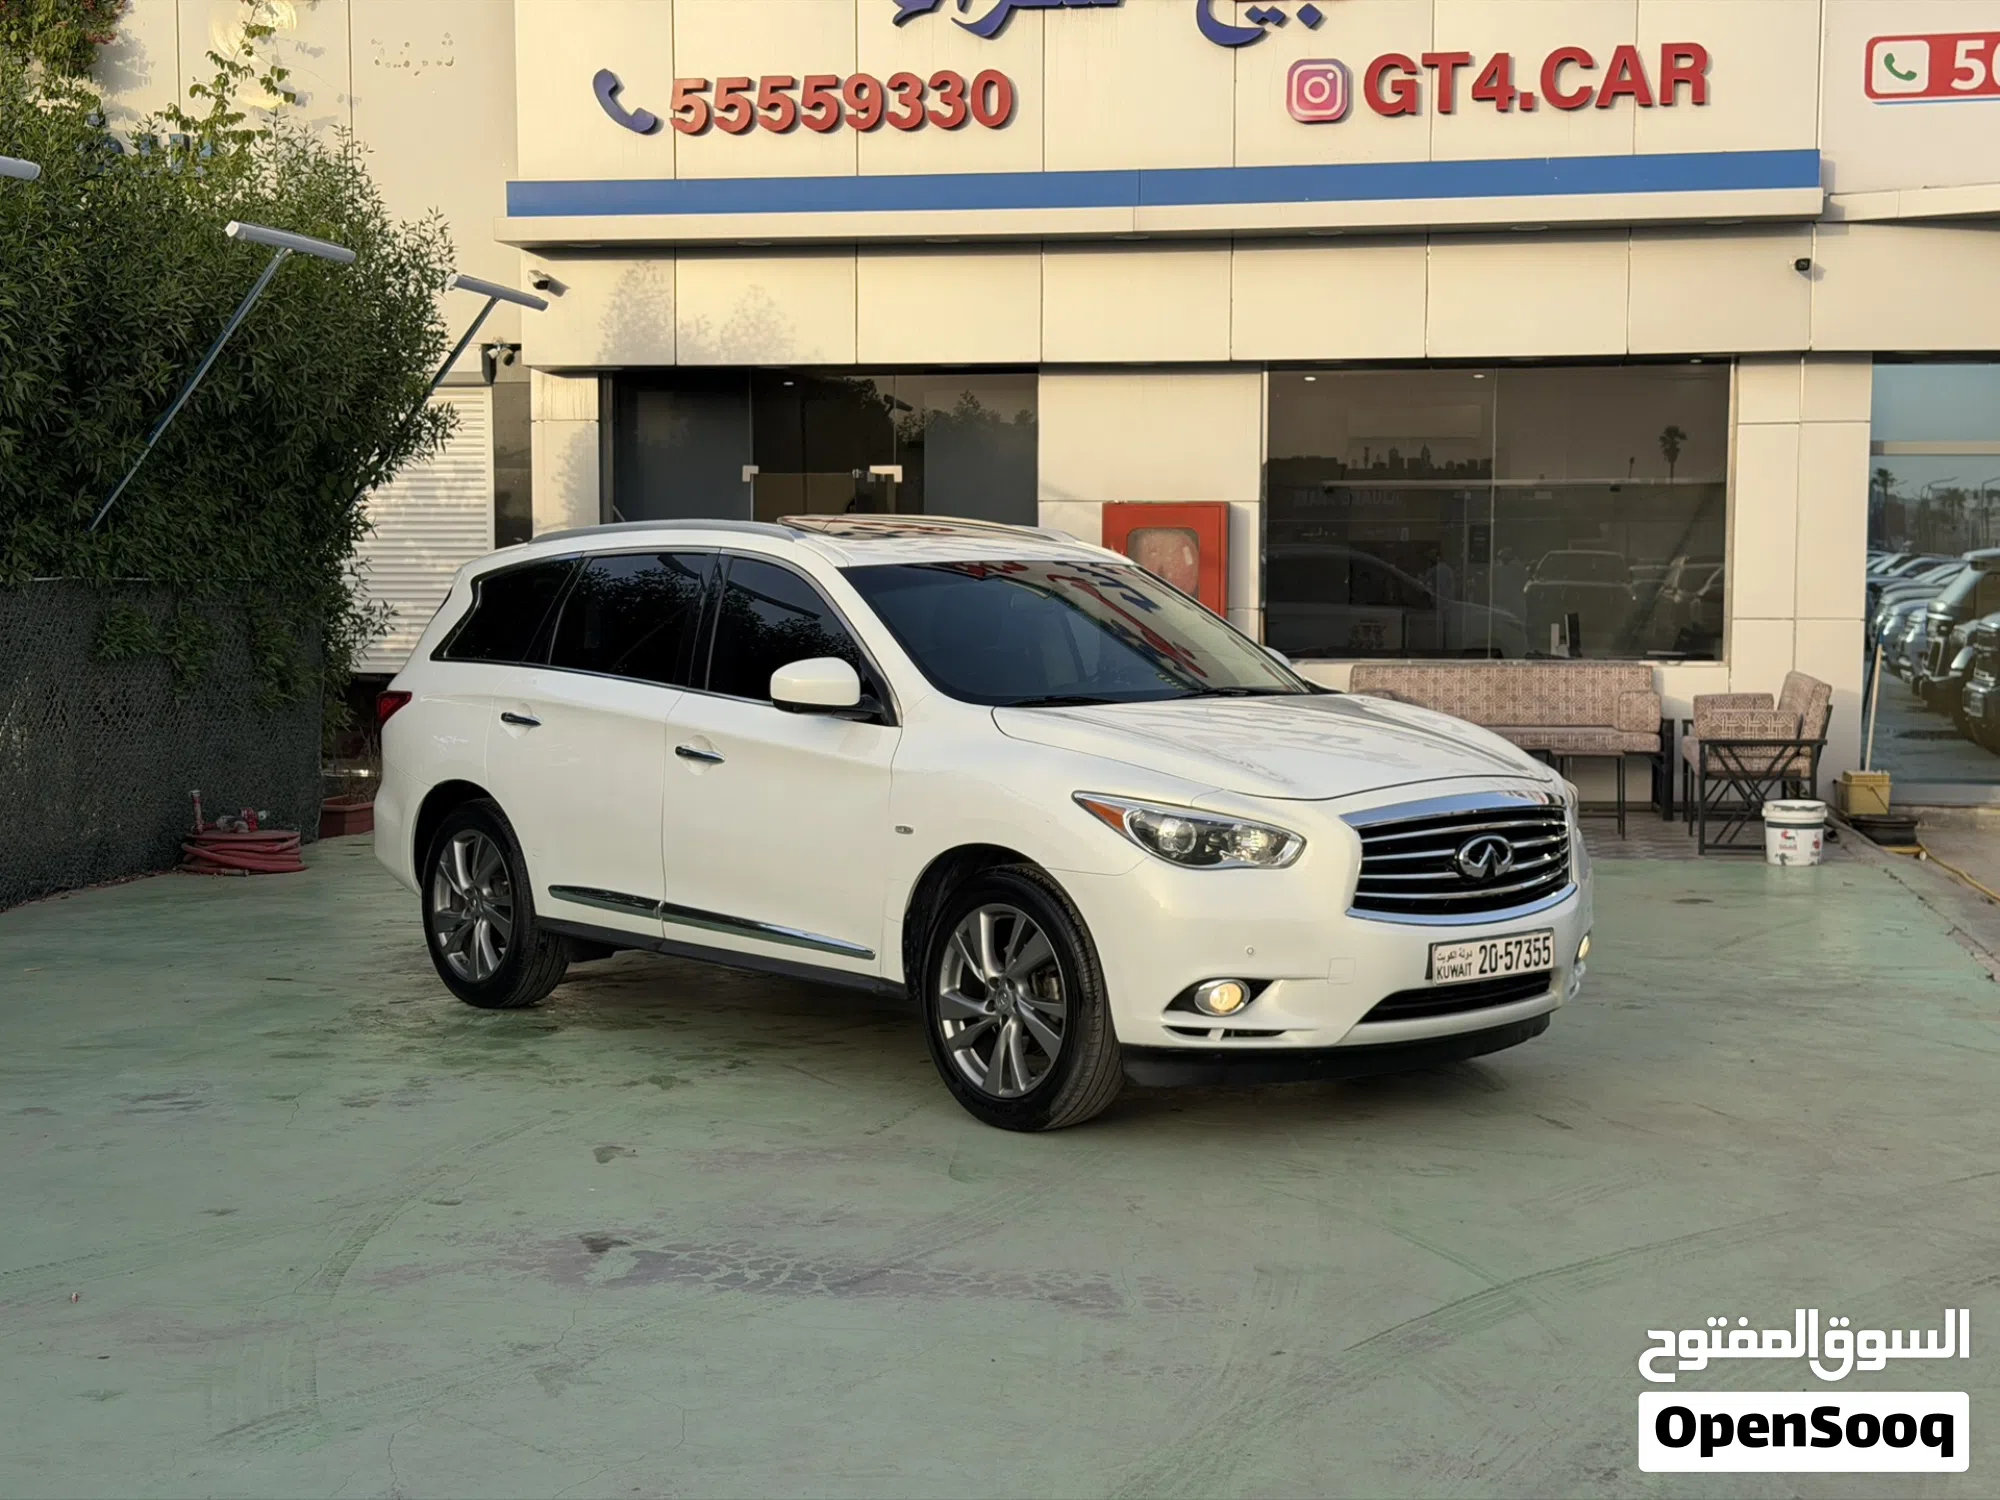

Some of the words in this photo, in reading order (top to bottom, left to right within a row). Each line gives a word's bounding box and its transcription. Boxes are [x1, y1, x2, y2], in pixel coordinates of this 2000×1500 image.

[1363, 42, 1708, 116] GT4.CAR
[1951, 39, 2000, 91] 5
[670, 69, 1014, 135] 55559330
[1436, 962, 1472, 980] KUWAIT
